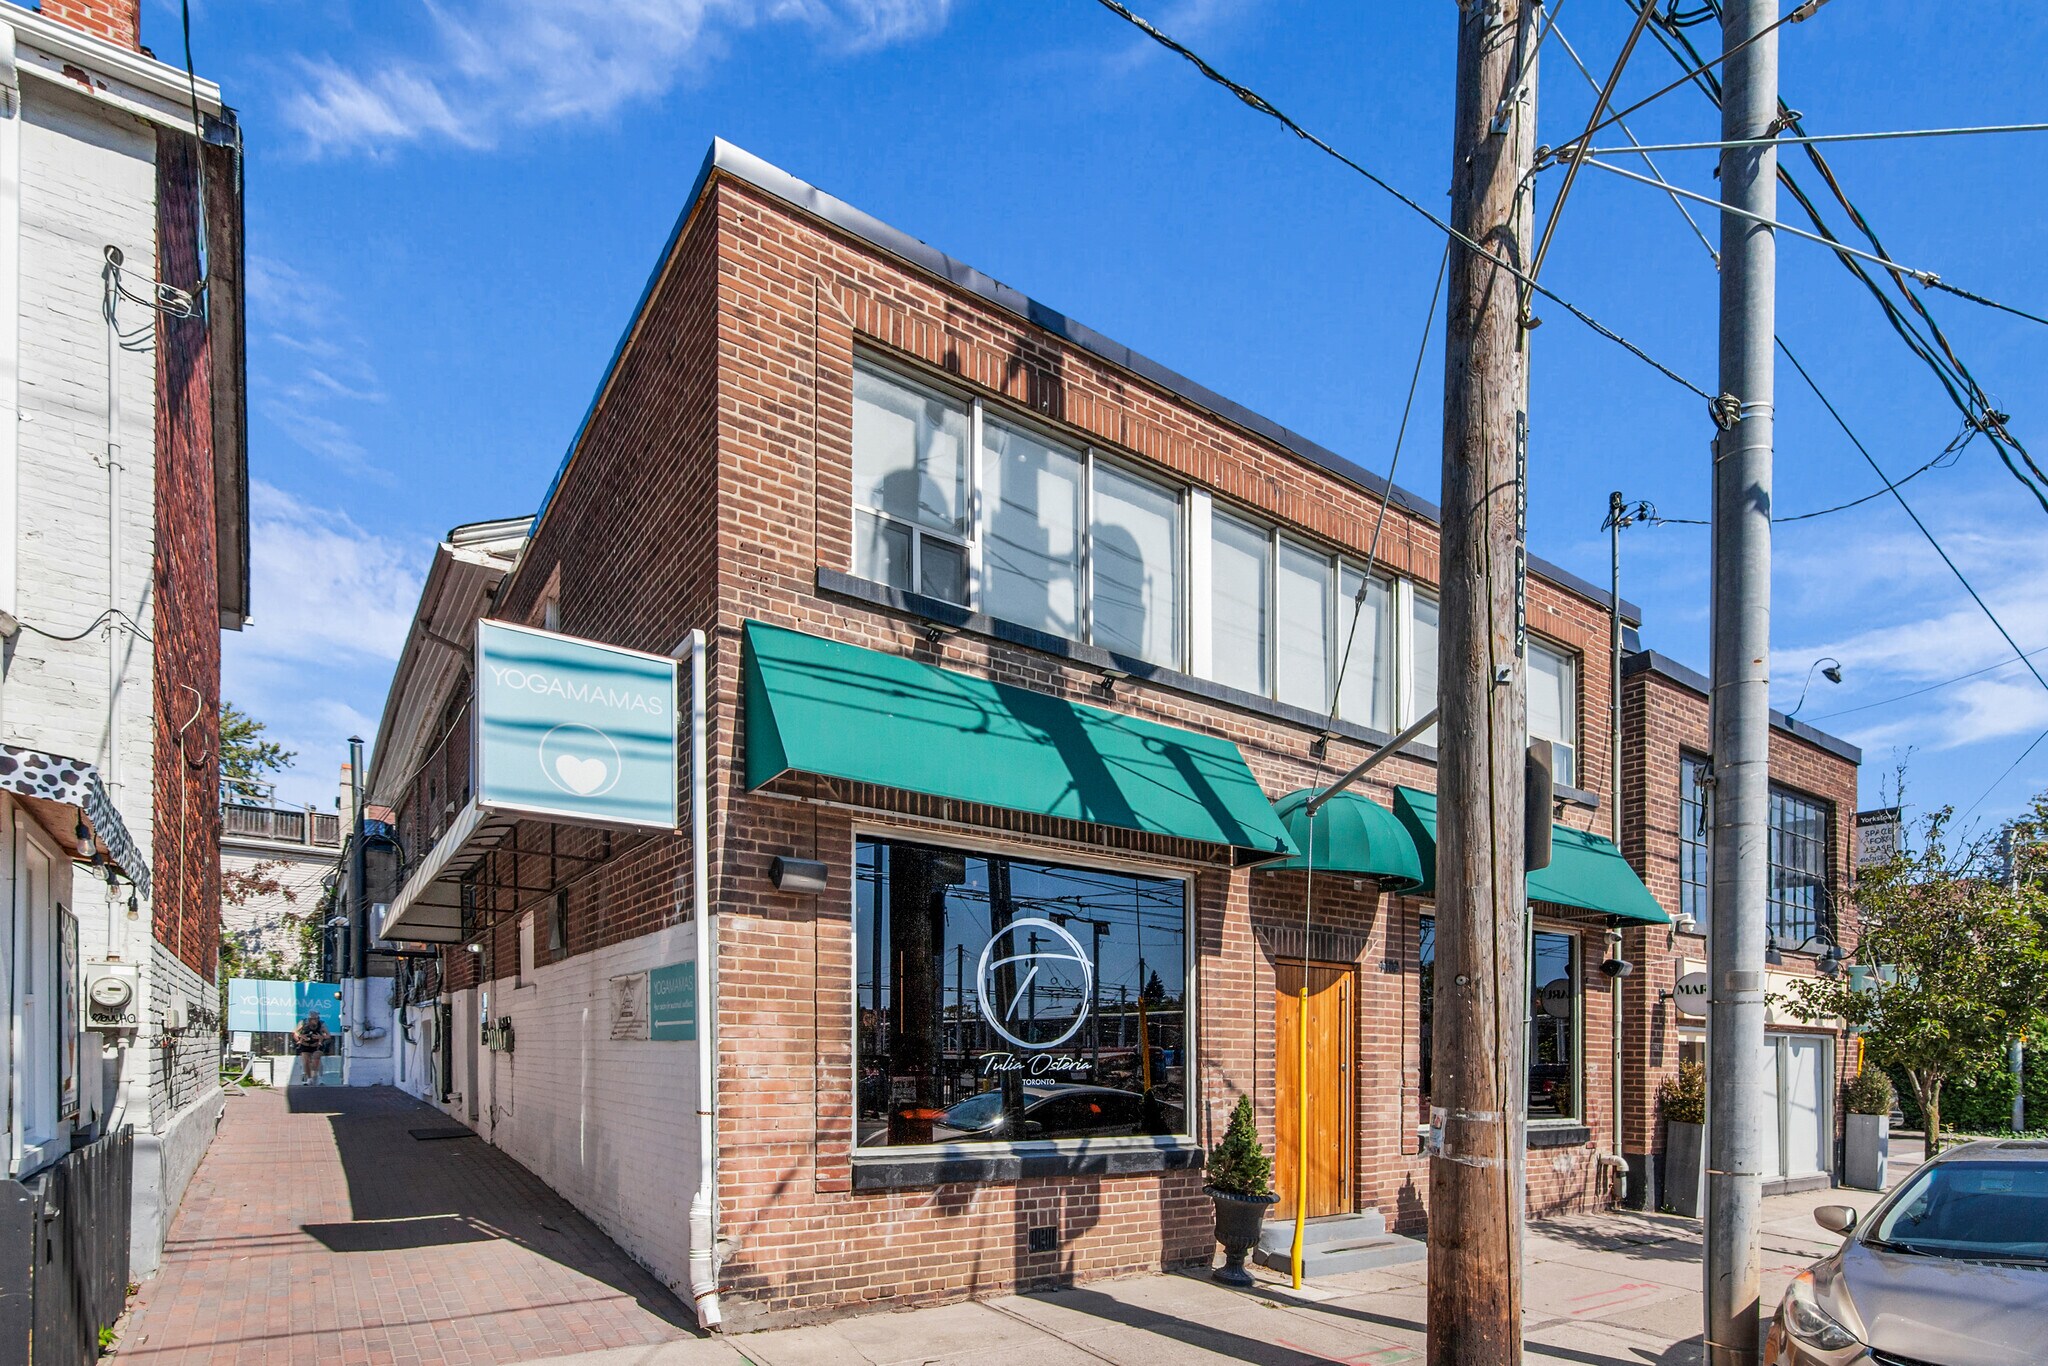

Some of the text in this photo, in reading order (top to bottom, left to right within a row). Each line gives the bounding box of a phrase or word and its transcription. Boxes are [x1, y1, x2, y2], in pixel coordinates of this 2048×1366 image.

[1517, 557, 1525, 646] P1402
[489, 665, 663, 716] YOGAMAMAS
[1860, 813, 1897, 824] Yorkstoe
[654, 975, 694, 995] YOGAMAMAS
[240, 995, 332, 1009] YOGAMAMAS
[979, 1051, 1093, 1075] Tulia Osteria
[1022, 1078, 1056, 1086] TORONTO
